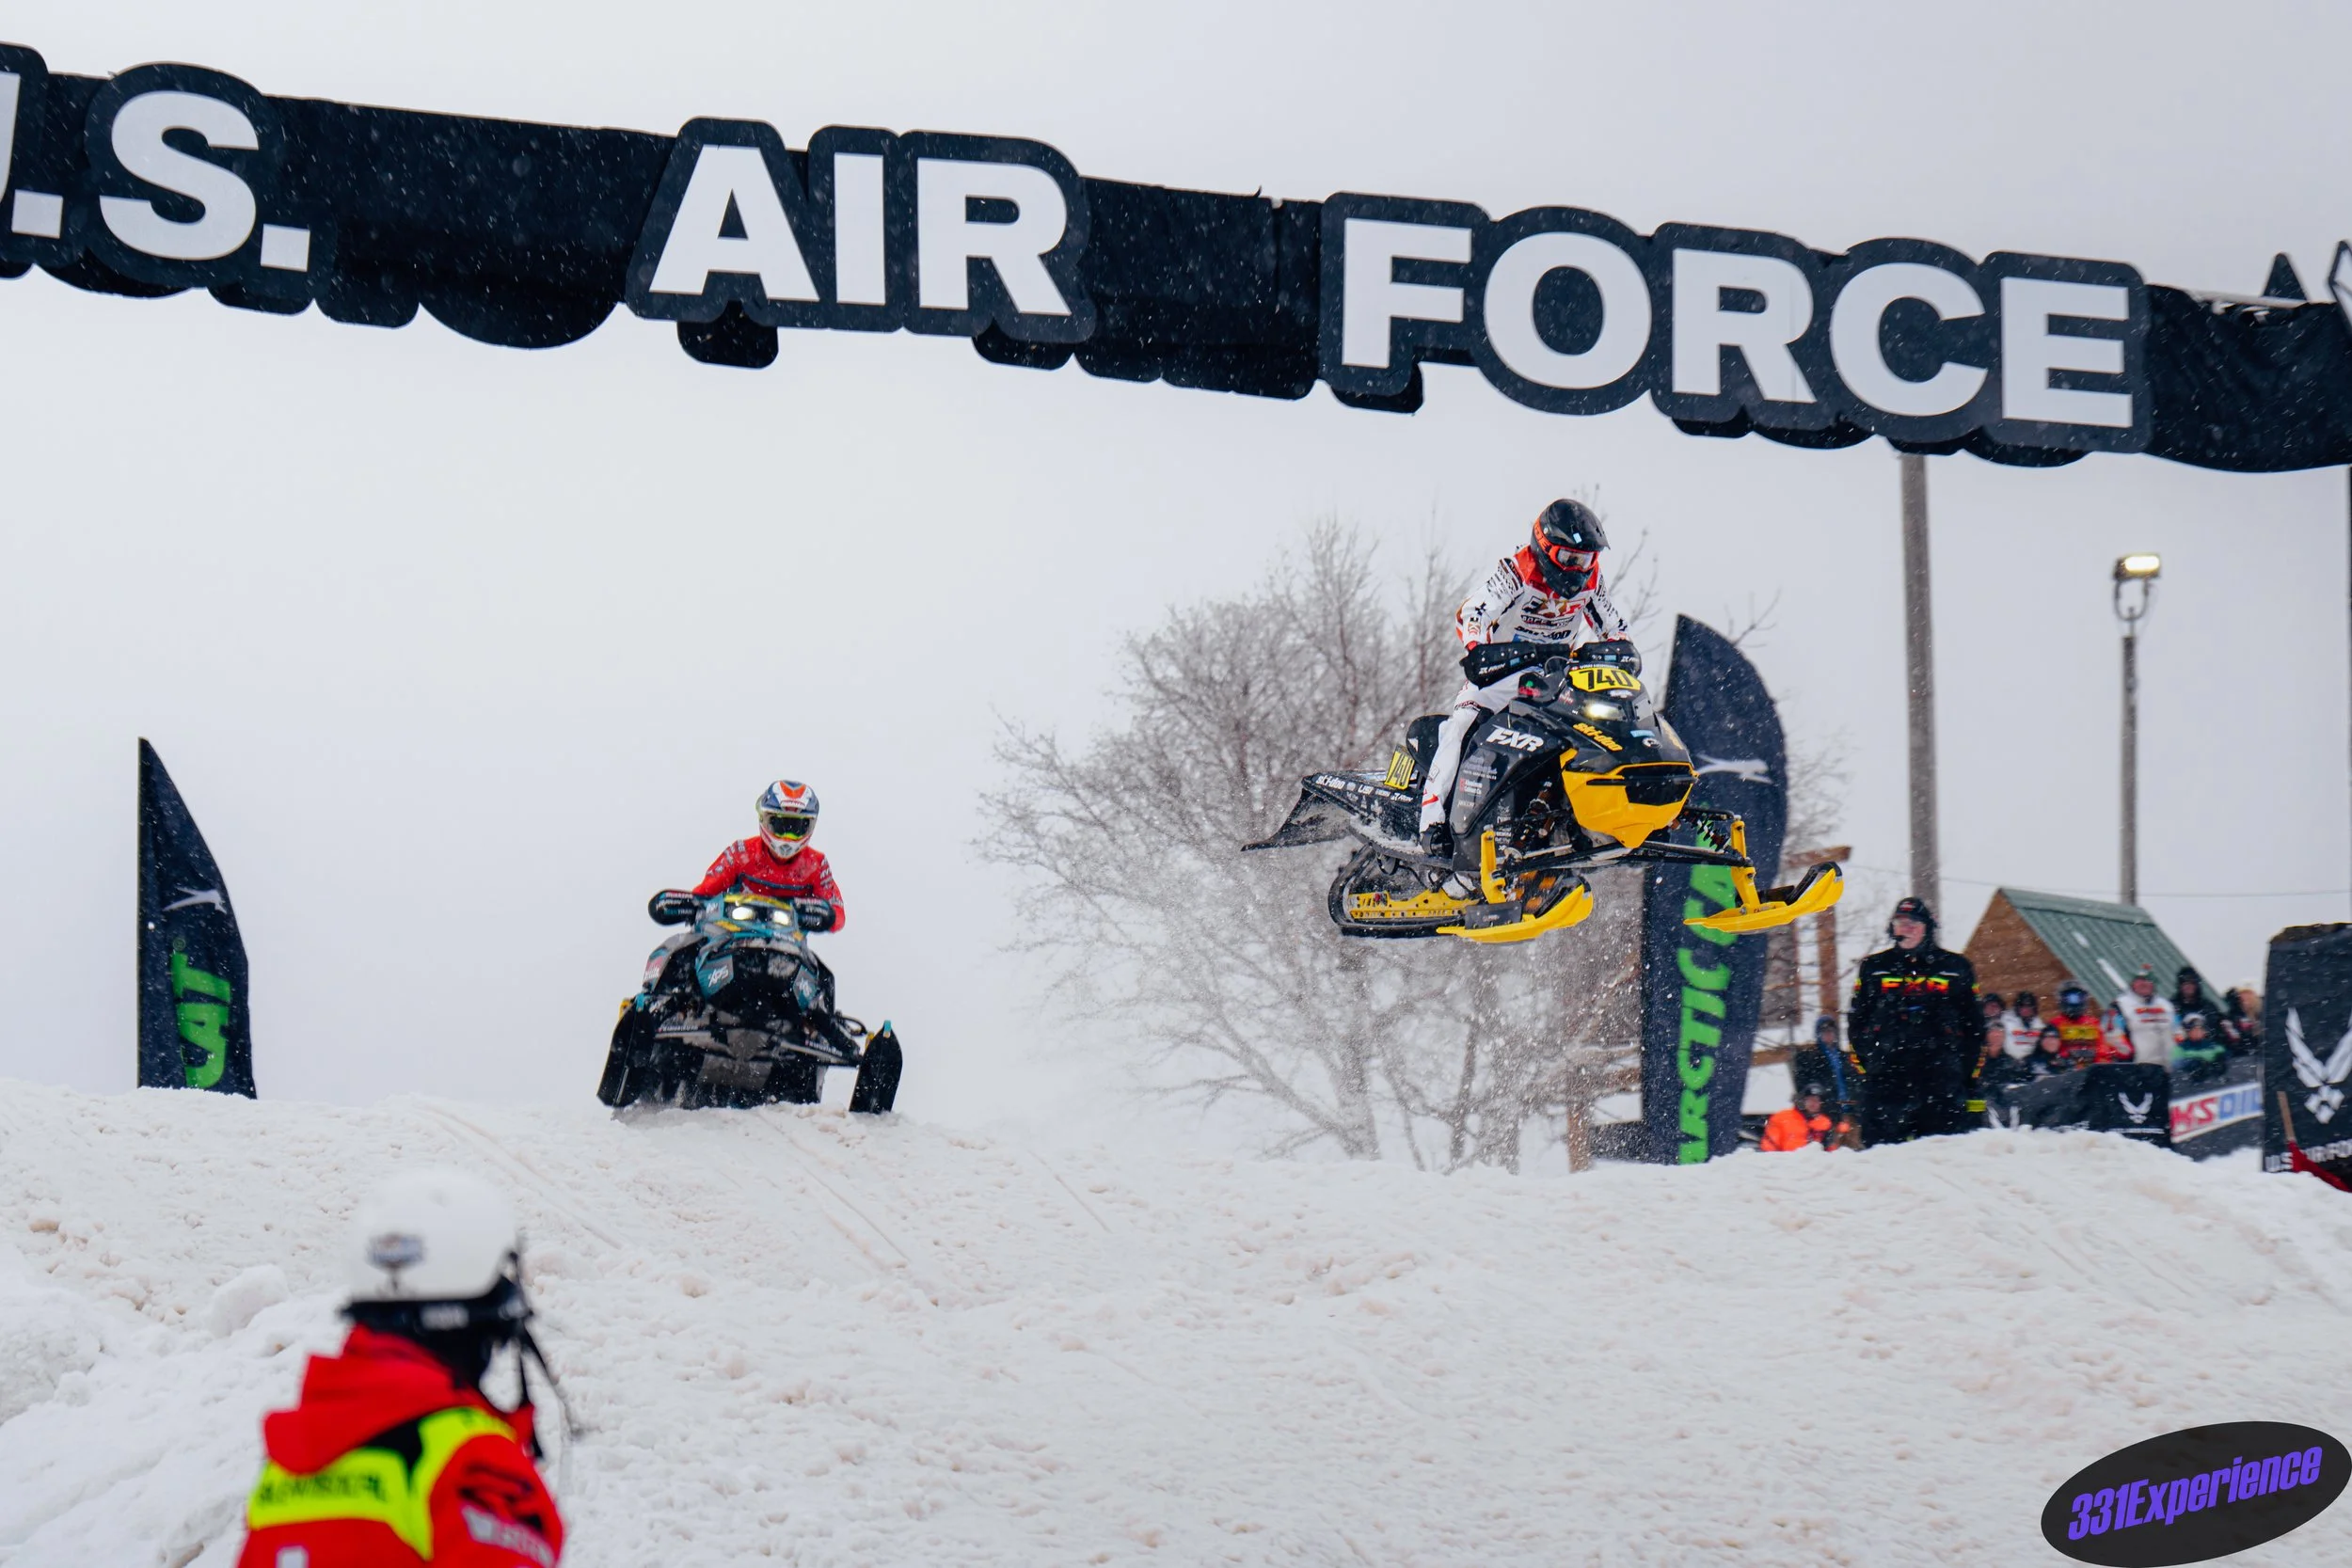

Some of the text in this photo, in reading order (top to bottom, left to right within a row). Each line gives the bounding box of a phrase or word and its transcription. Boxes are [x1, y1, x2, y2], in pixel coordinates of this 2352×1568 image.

[0, 71, 2134, 429] .S. AIR FORCE
[1579, 669, 1634, 690] 740
[1486, 724, 1545, 752] FXR
[170, 948, 231, 1089] CAT
[1881, 974, 1950, 996] FXR
[1677, 948, 1733, 1165] ARCTIC
